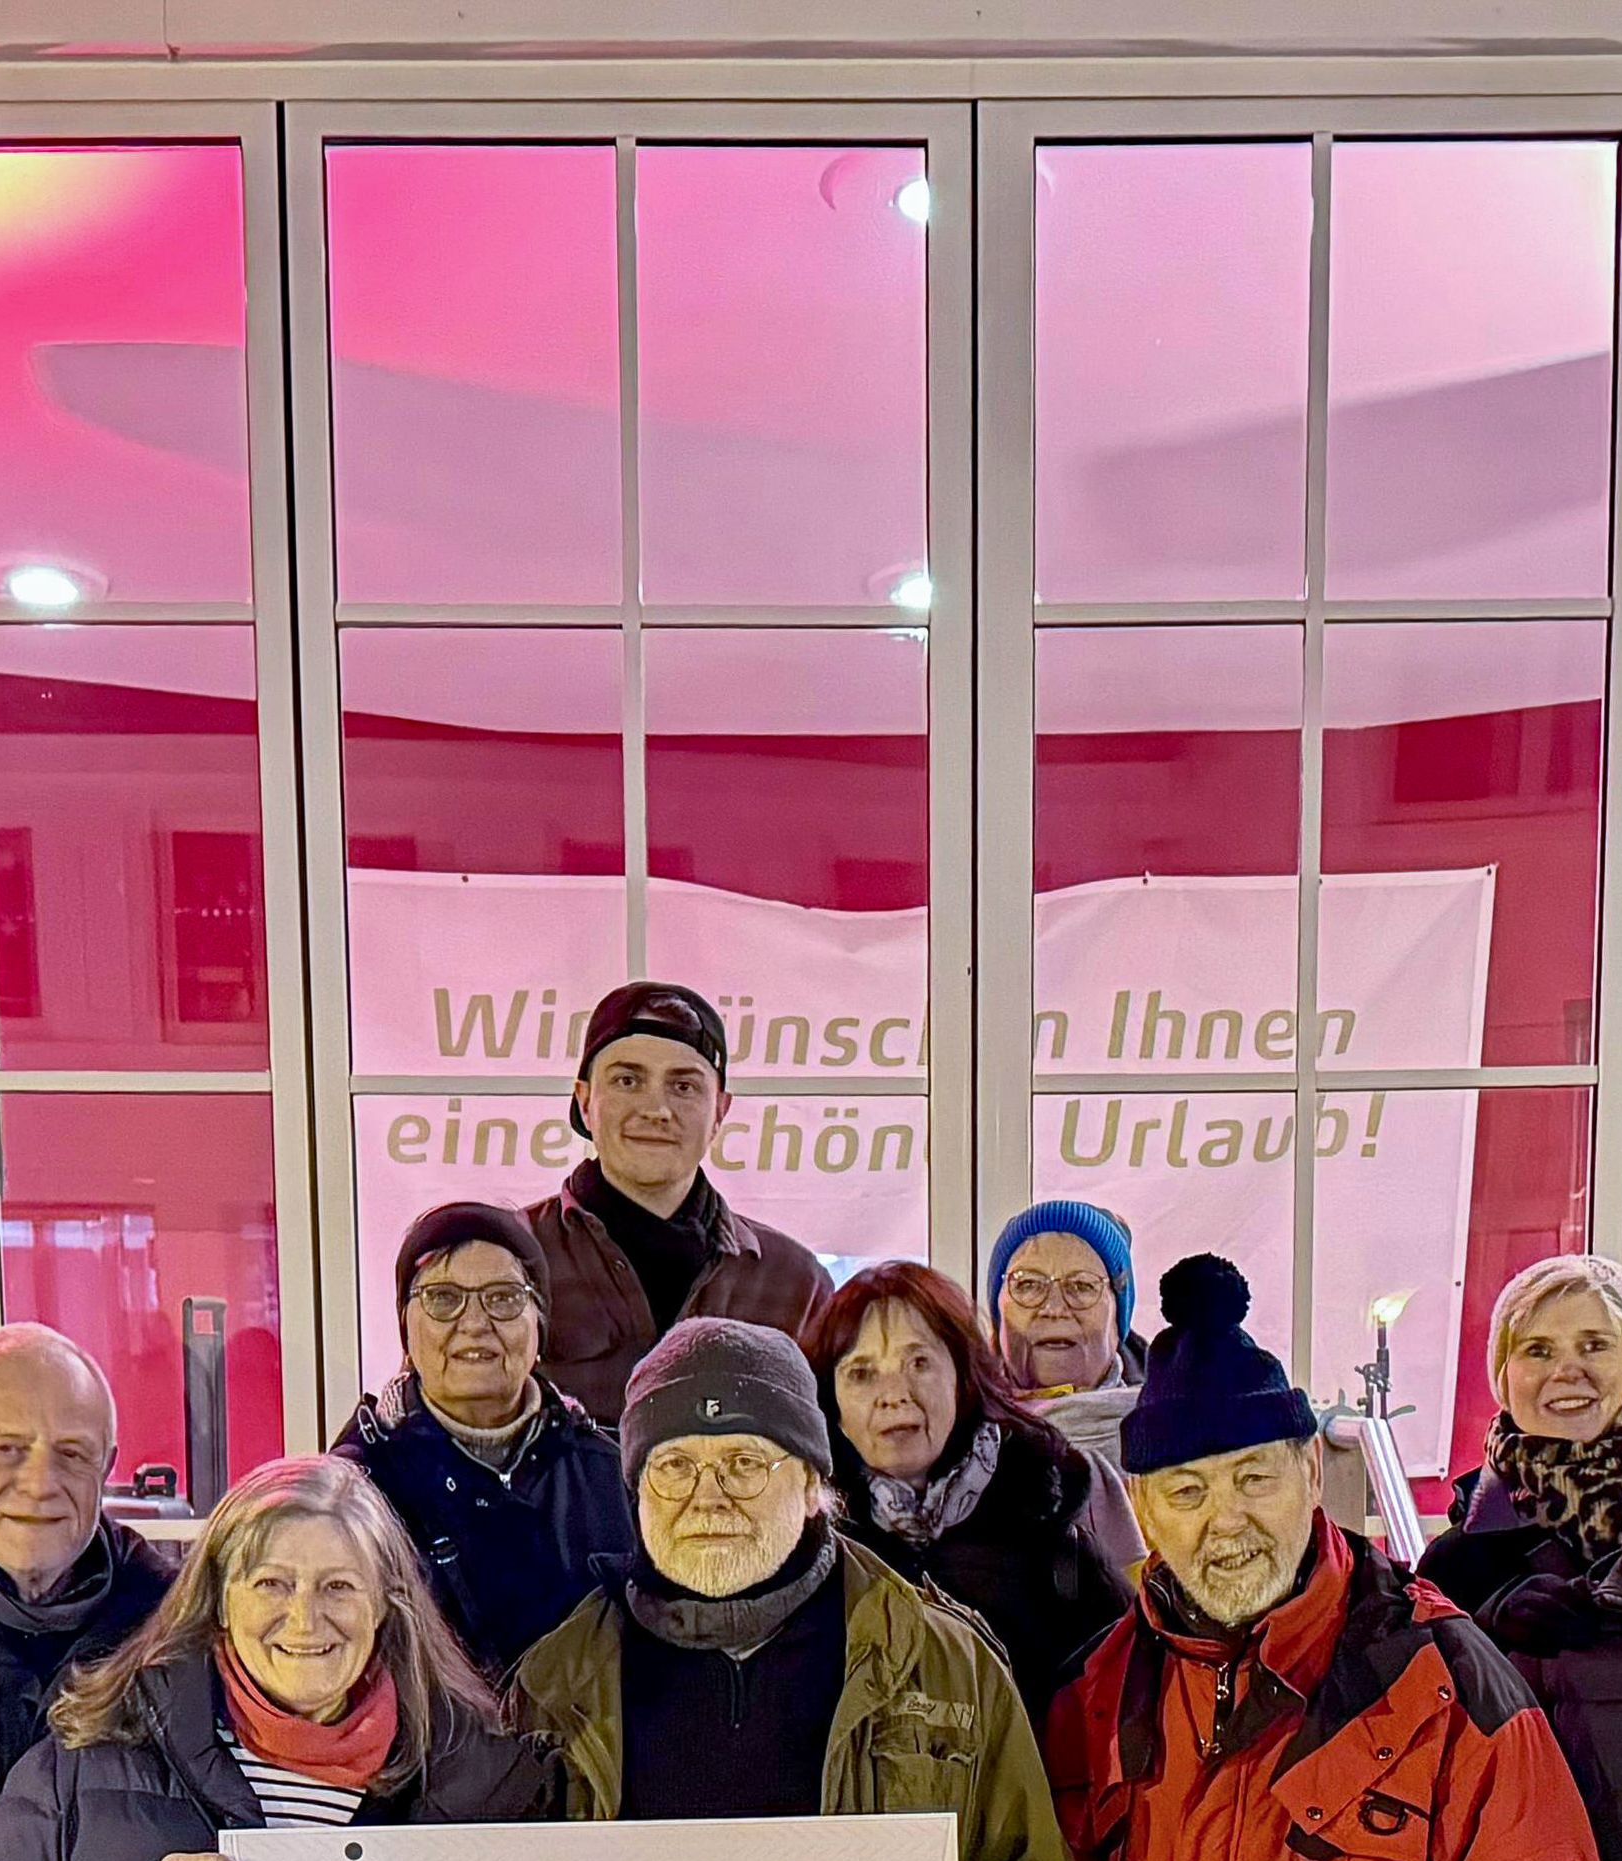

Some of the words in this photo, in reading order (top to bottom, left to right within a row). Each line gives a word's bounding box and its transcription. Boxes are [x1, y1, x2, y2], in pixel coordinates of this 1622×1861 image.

[715, 995, 1069, 1067] ünscn
[1106, 989, 1357, 1061] Ihnen
[386, 1097, 575, 1169] eine
[711, 1103, 929, 1174] chön
[1059, 1090, 1386, 1170] Urlaub!
